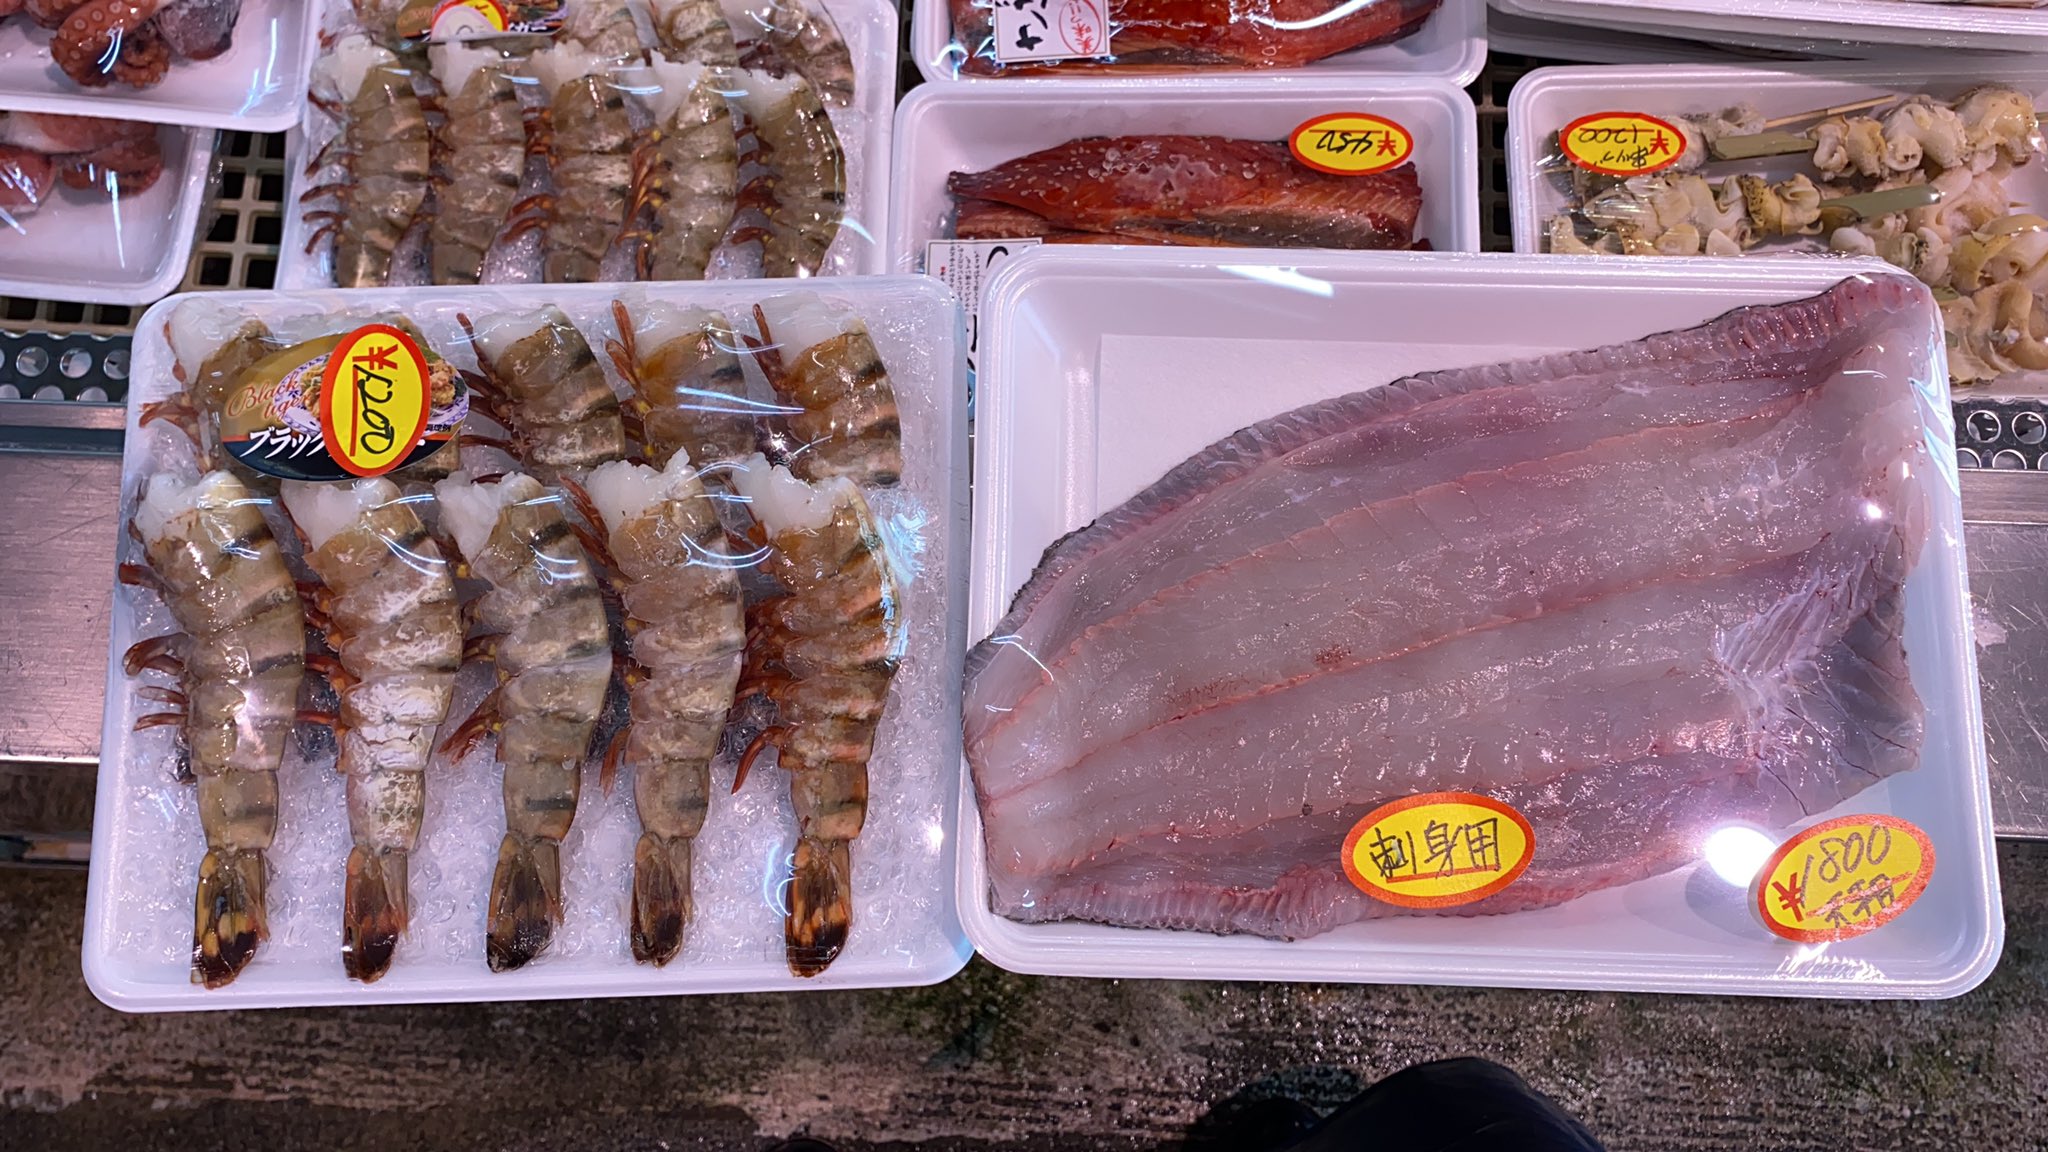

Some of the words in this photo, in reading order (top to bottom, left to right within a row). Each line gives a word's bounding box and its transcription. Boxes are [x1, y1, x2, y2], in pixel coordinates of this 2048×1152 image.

[227, 371, 298, 417] Black
[264, 393, 311, 422] tiger
[1369, 817, 1502, 879] 刺身用
